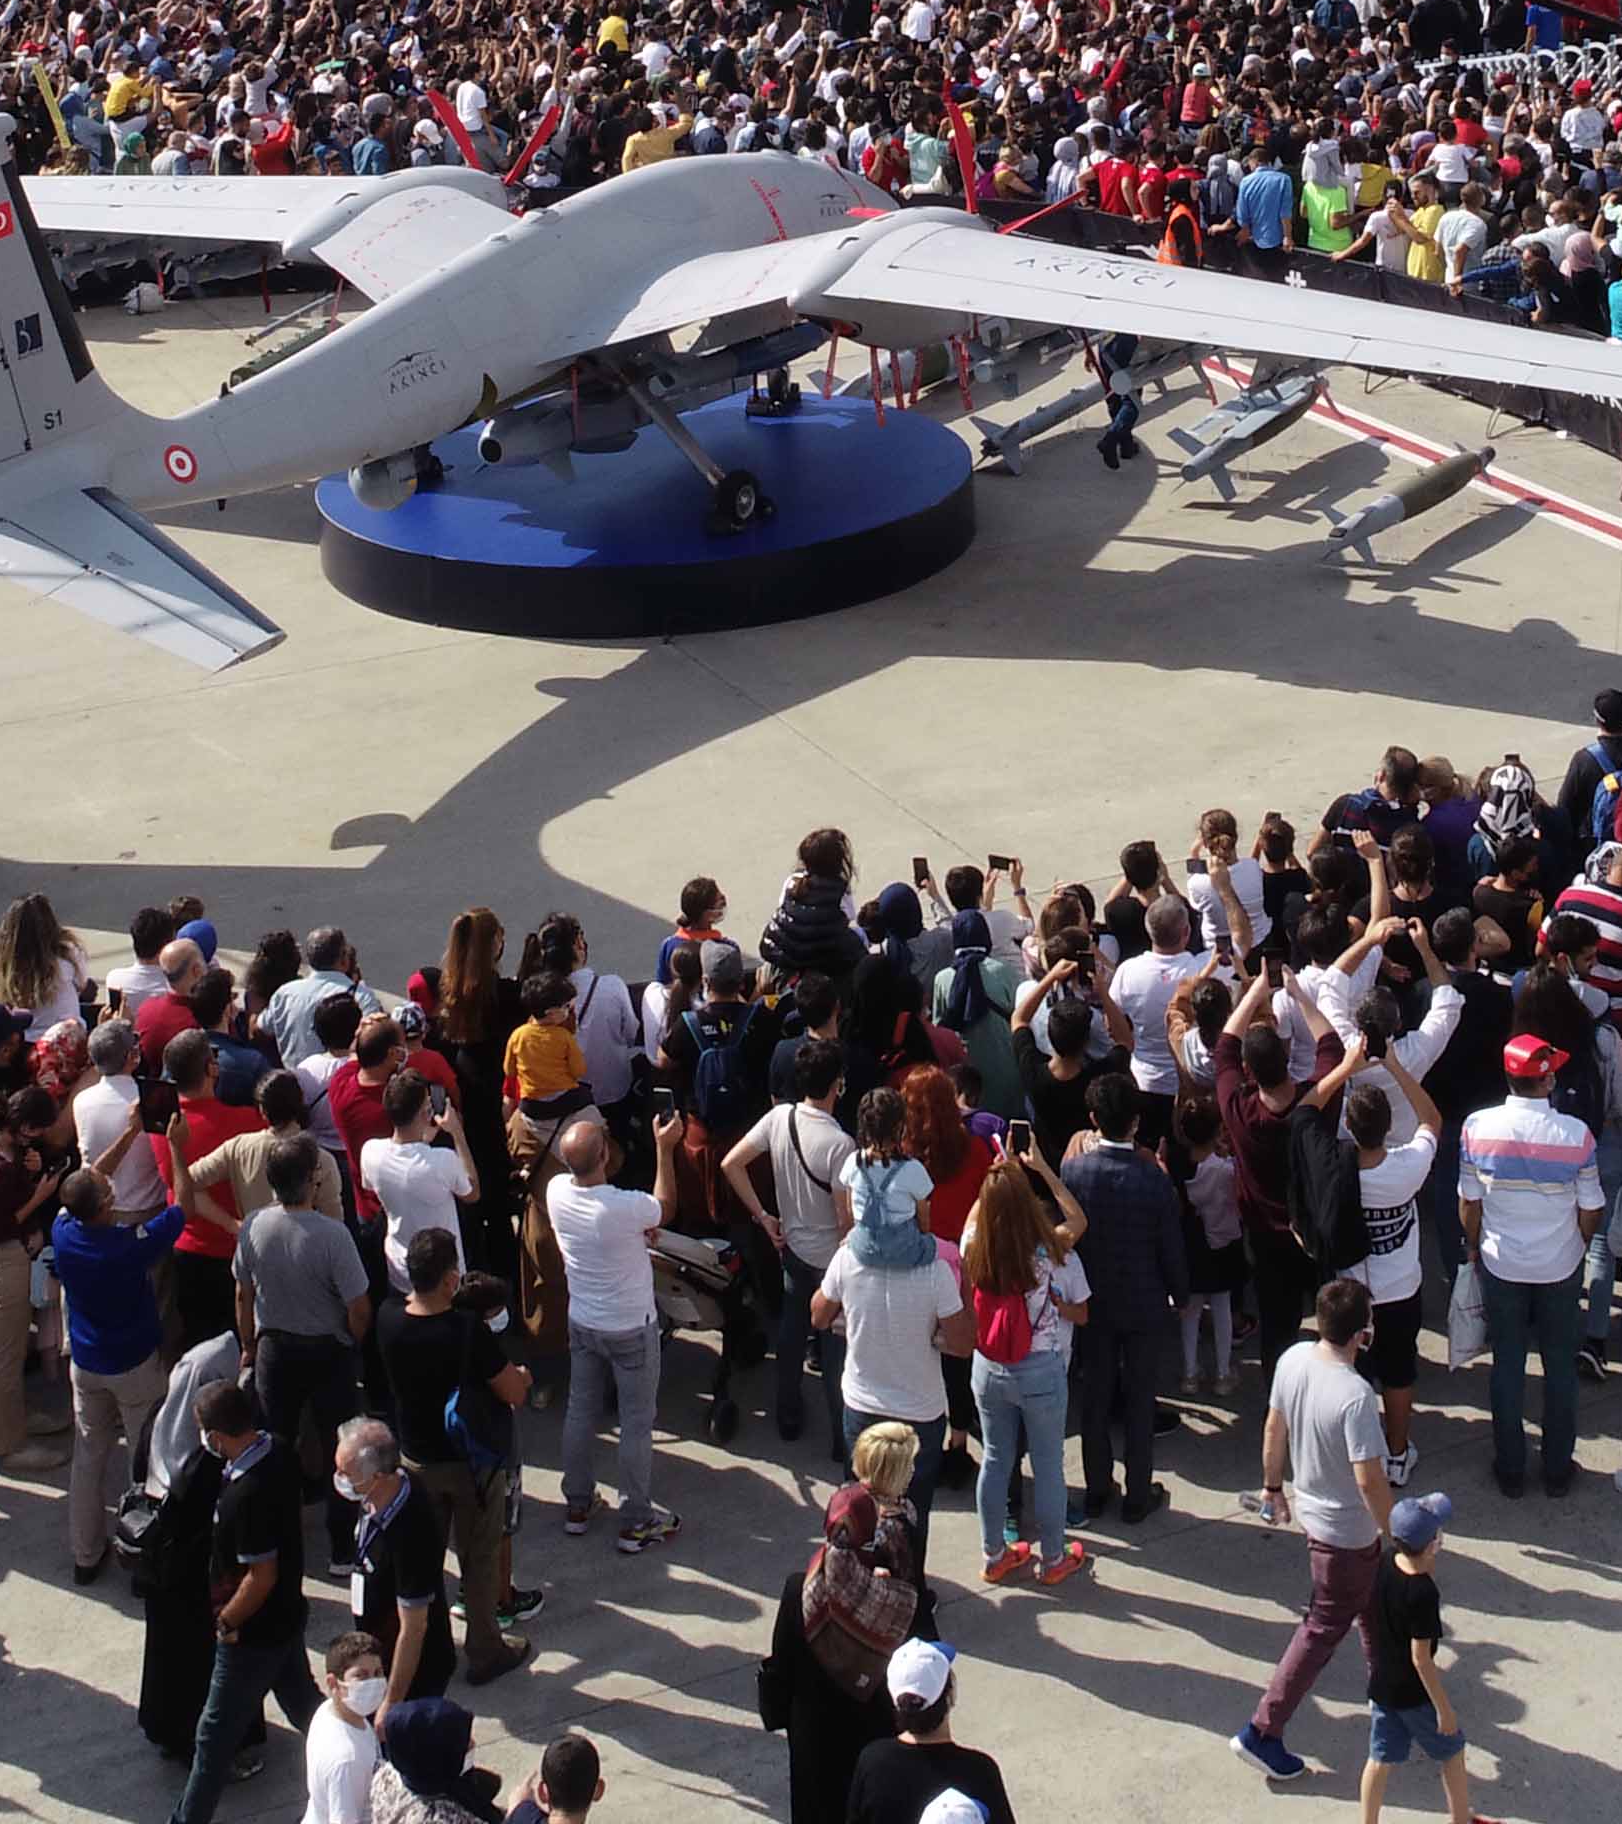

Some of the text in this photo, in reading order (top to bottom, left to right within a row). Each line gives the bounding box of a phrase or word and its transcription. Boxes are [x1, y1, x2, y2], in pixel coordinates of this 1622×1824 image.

[1015, 258, 1176, 288] AKINCI
[389, 360, 446, 395] AKINCI
[43, 408, 63, 430] S1
